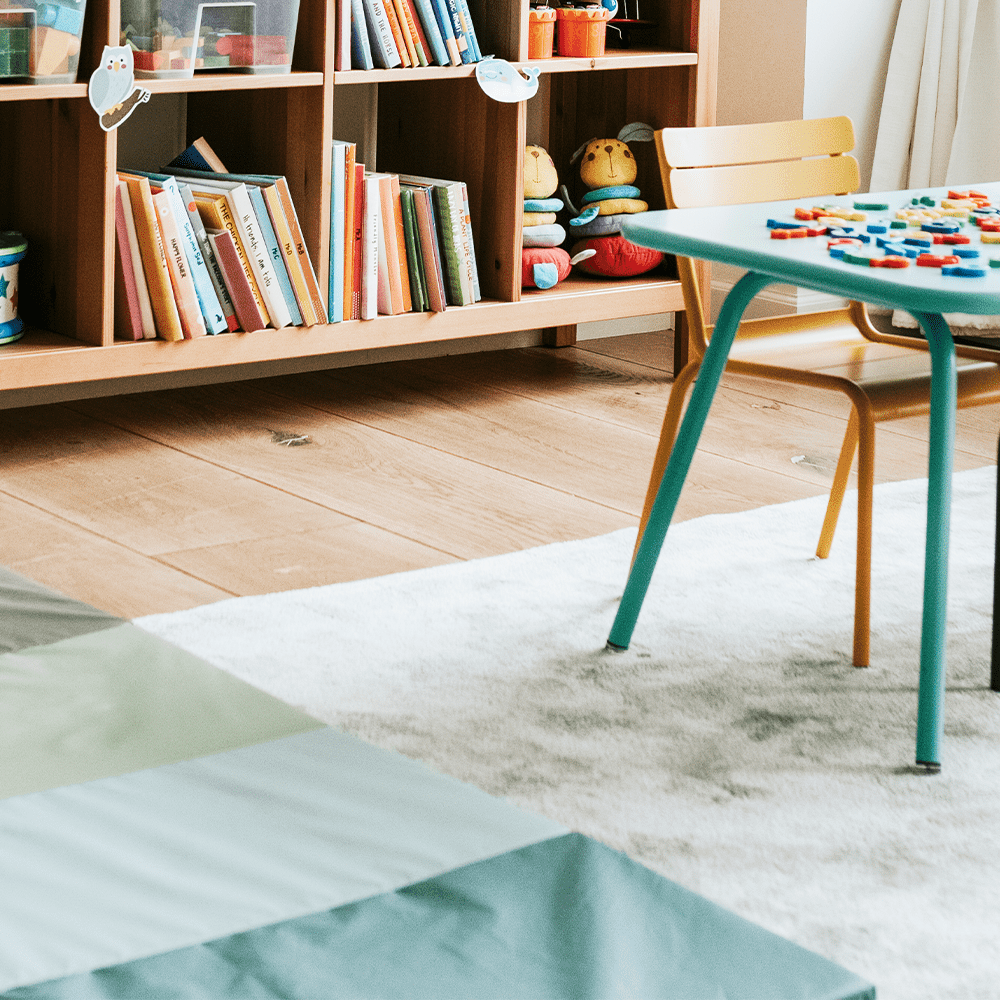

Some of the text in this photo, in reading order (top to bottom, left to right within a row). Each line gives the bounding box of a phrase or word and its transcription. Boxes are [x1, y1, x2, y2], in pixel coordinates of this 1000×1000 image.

[373, 2, 382, 17] AND
[378, 19, 386, 32] THE
[382, 35, 393, 56] HORSE
[219, 203, 230, 220] THE
